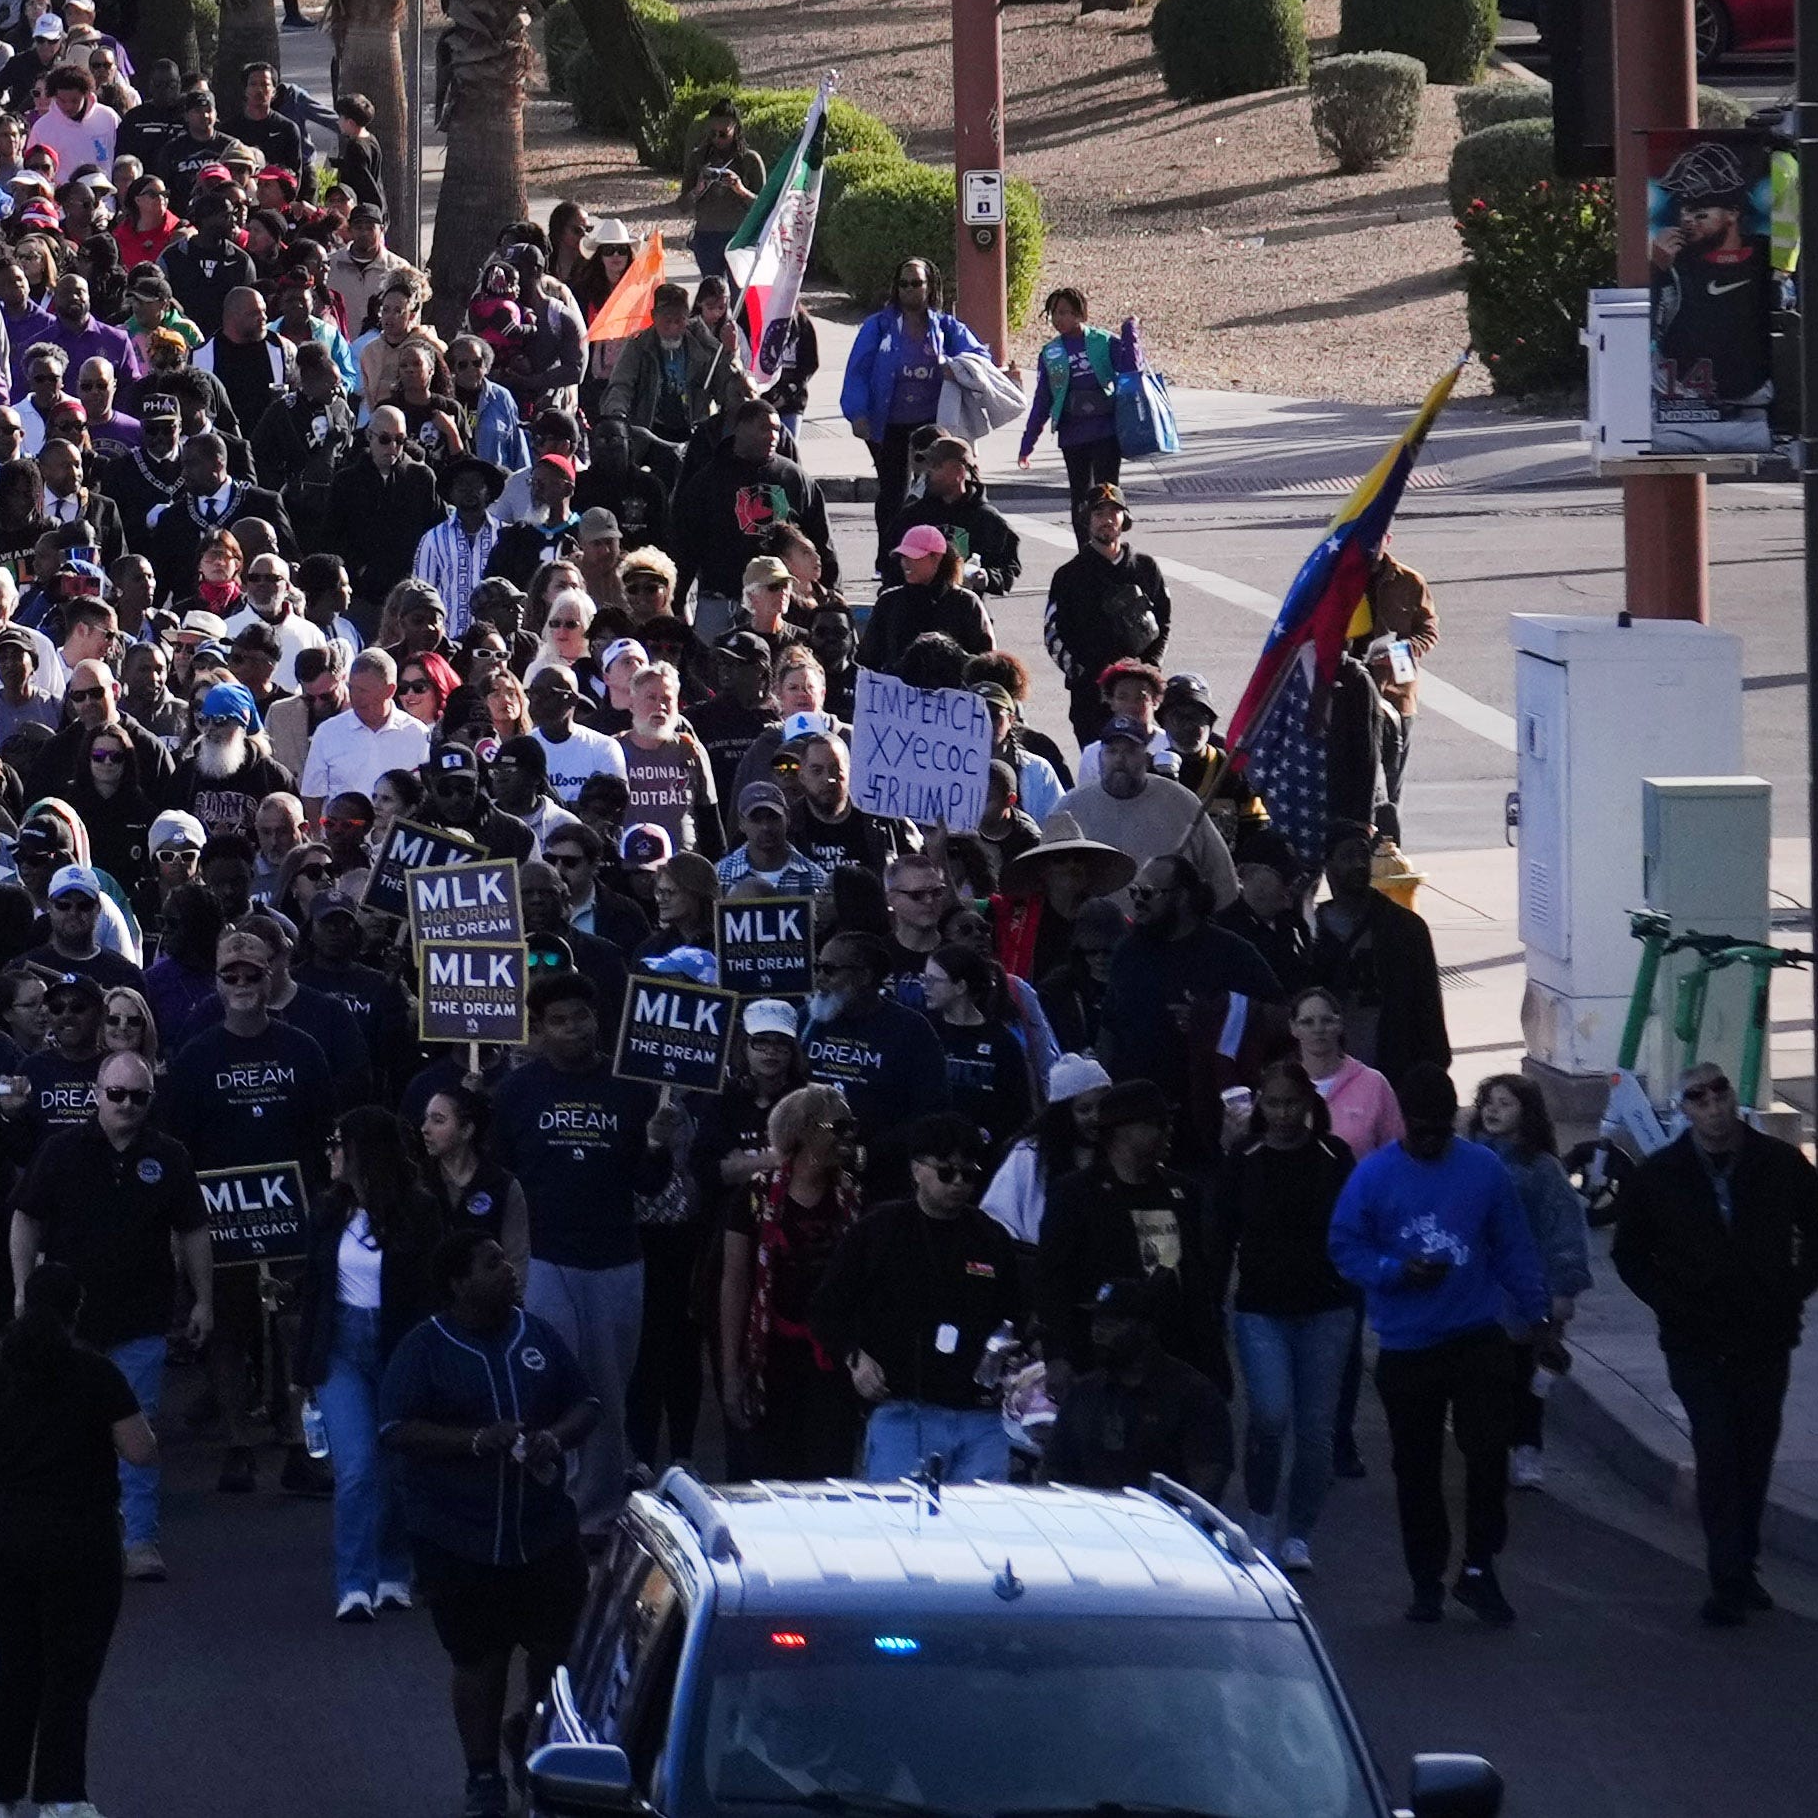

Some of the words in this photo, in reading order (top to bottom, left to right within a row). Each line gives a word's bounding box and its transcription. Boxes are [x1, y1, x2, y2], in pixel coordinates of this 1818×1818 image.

[1659, 410, 1720, 421] MORENO
[866, 670, 985, 738] IMPEACH
[380, 874, 405, 892] THE
[417, 872, 508, 912] MLK
[420, 904, 510, 924] HONORING
[421, 925, 452, 940] THE
[457, 919, 511, 935] DREAM
[725, 909, 803, 945] MLK
[429, 952, 515, 987] MLK
[726, 958, 754, 971] THE
[758, 957, 805, 970] DREAM
[430, 986, 516, 1001] HONORING
[430, 1001, 459, 1014] THE
[464, 1003, 516, 1016] DREAM
[633, 989, 722, 1036] MLK
[630, 1038, 660, 1056] THE
[664, 1045, 716, 1064] DREAM
[809, 1041, 883, 1069] DREAM
[217, 1068, 295, 1090] DREAM
[539, 1111, 618, 1131] DREAM
[200, 1175, 294, 1214] MLK
[210, 1231, 240, 1240] THE
[243, 1222, 300, 1239] LEGACY
